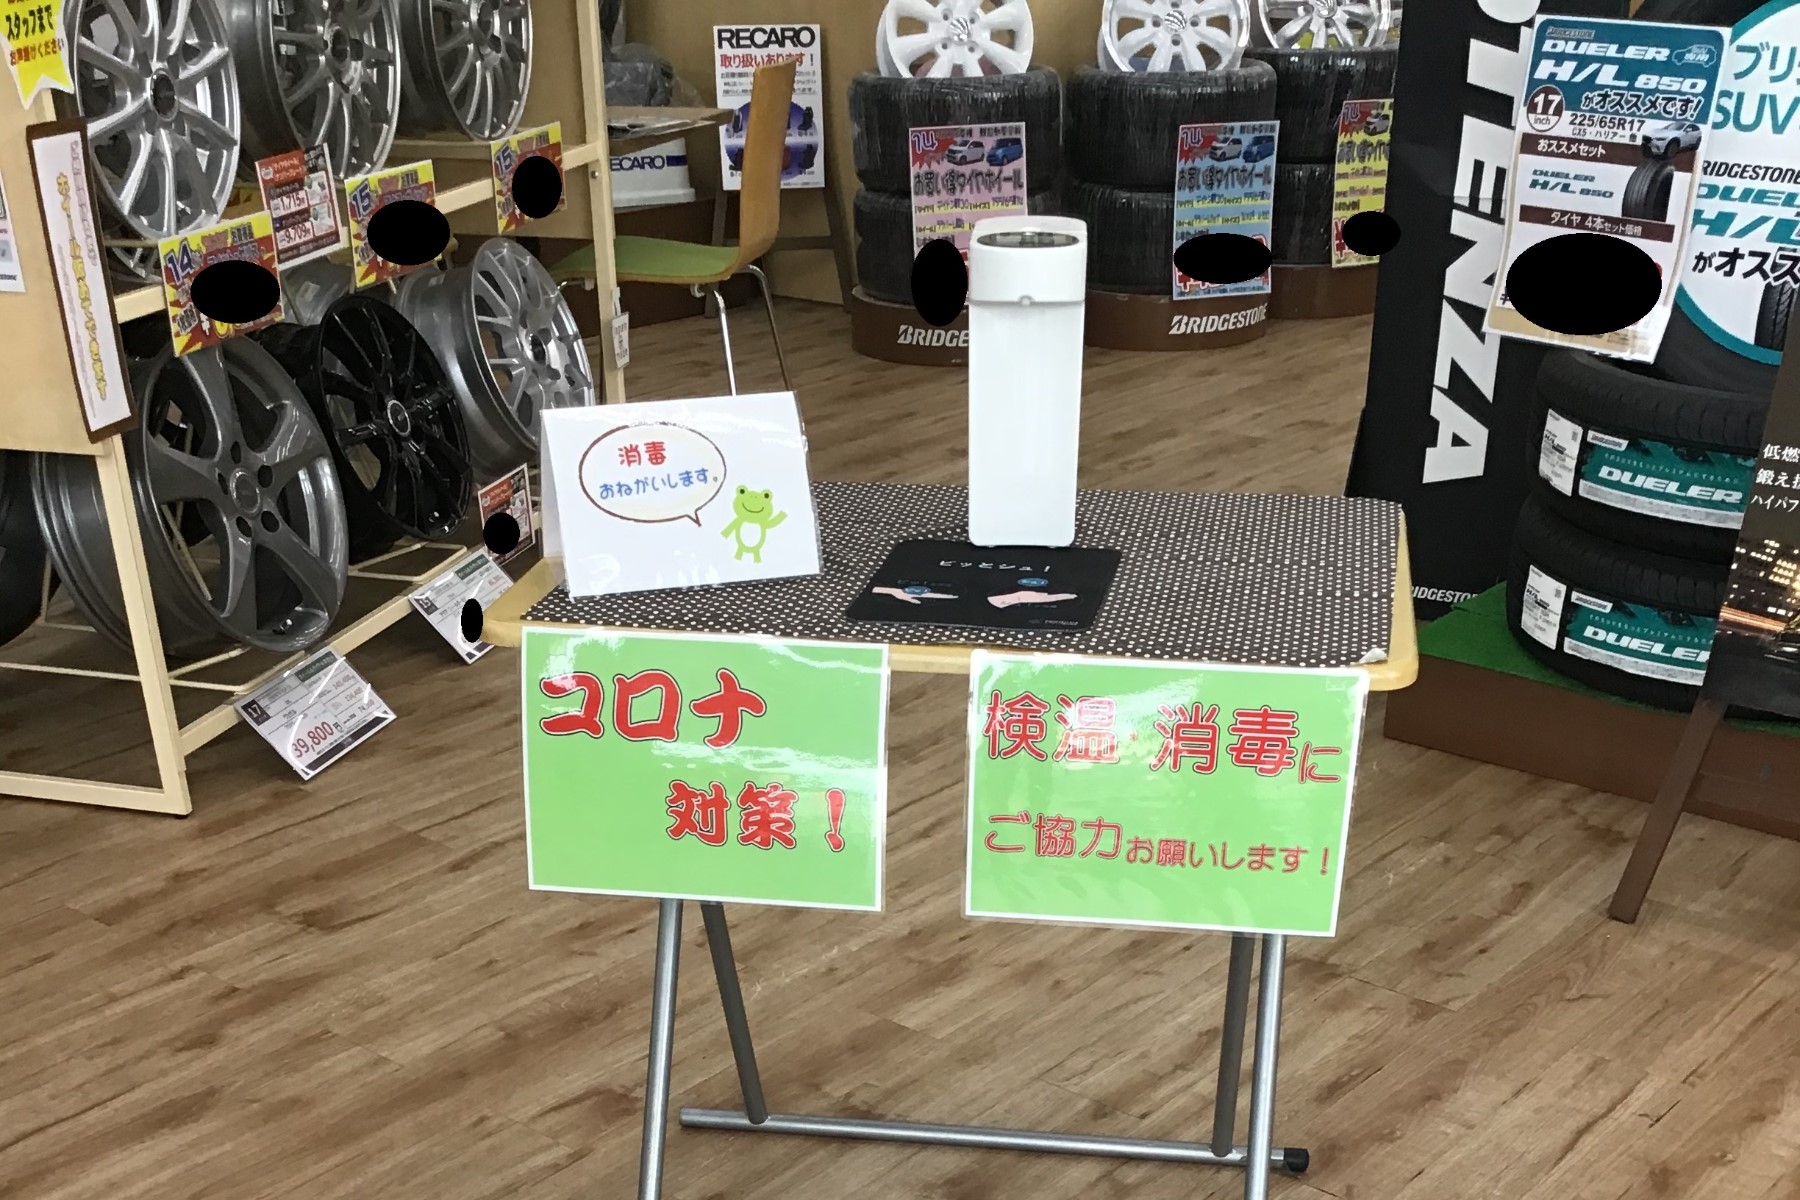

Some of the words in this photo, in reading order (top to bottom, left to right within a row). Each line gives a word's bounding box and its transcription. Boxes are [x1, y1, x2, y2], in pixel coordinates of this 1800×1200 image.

[5, 4, 54, 41] スタッフまで
[717, 26, 816, 49] RECARO
[1541, 39, 1671, 62] DUELER
[1733, 41, 1800, 85] ブリ
[1533, 59, 1630, 87] H/L
[1634, 74, 1708, 93] 850
[1534, 92, 1561, 115] 17
[1533, 114, 1551, 126] inch
[1568, 112, 1646, 132] 225/65R17
[912, 131, 938, 154] 14
[1182, 127, 1204, 150] 14
[1537, 138, 1607, 158] おススメセット
[1532, 169, 1596, 182] DUELER
[350, 178, 372, 219] 15
[1529, 179, 1576, 195] H/L
[1579, 189, 1614, 199] 850
[1550, 211, 1582, 227] タイヤ
[1421, 0, 1541, 484] TENZA
[164, 237, 195, 285] 14
[1168, 302, 1268, 335] BRIDGESTONE
[897, 324, 969, 347] BRIDGE
[617, 441, 667, 467] 消毒
[599, 468, 718, 500] おねがいします。
[1598, 465, 1744, 504] DUELER
[1412, 586, 1479, 603] IDGESTO
[540, 668, 767, 749] コロナ
[665, 779, 846, 853] 対策！
[984, 811, 1331, 877] ご協力お願いします！
